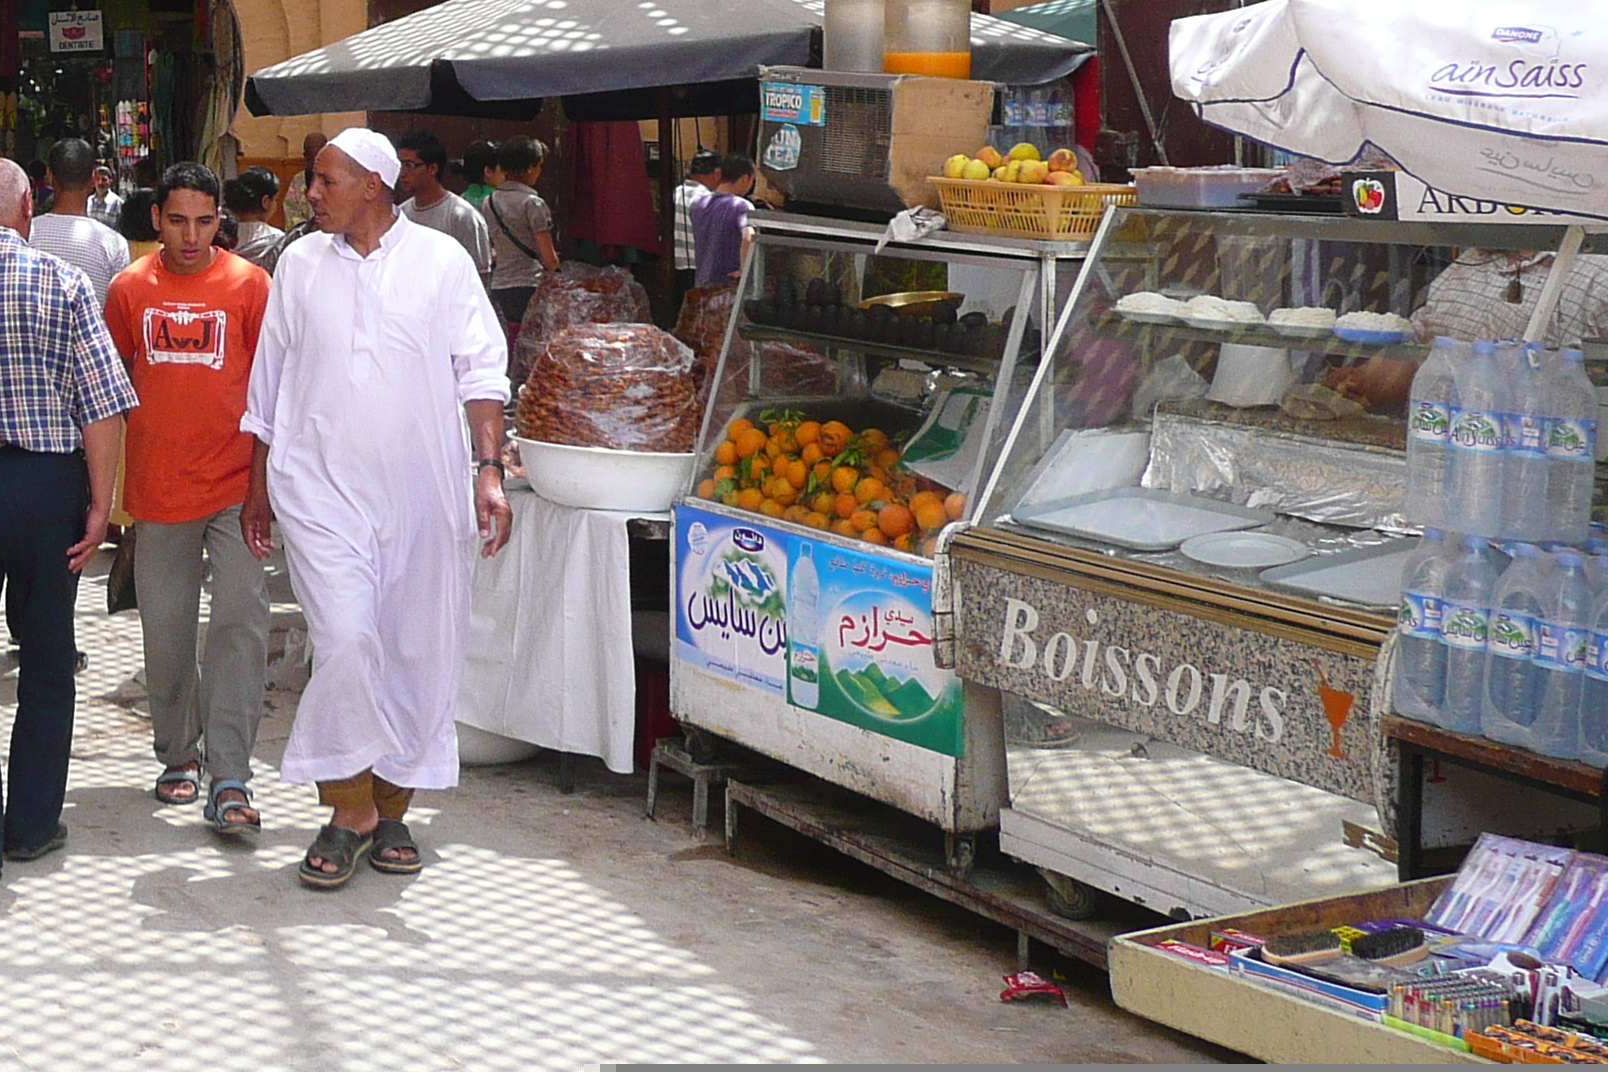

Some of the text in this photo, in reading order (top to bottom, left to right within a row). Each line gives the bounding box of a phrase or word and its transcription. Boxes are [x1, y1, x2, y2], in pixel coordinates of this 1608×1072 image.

[1495, 28, 1540, 41] DANONE
[765, 92, 802, 109] TROPICO
[771, 128, 798, 146] UN
[883, 609, 914, 627] سيدي
[839, 605, 933, 653] حرازم
[994, 596, 1288, 744] Boissons
